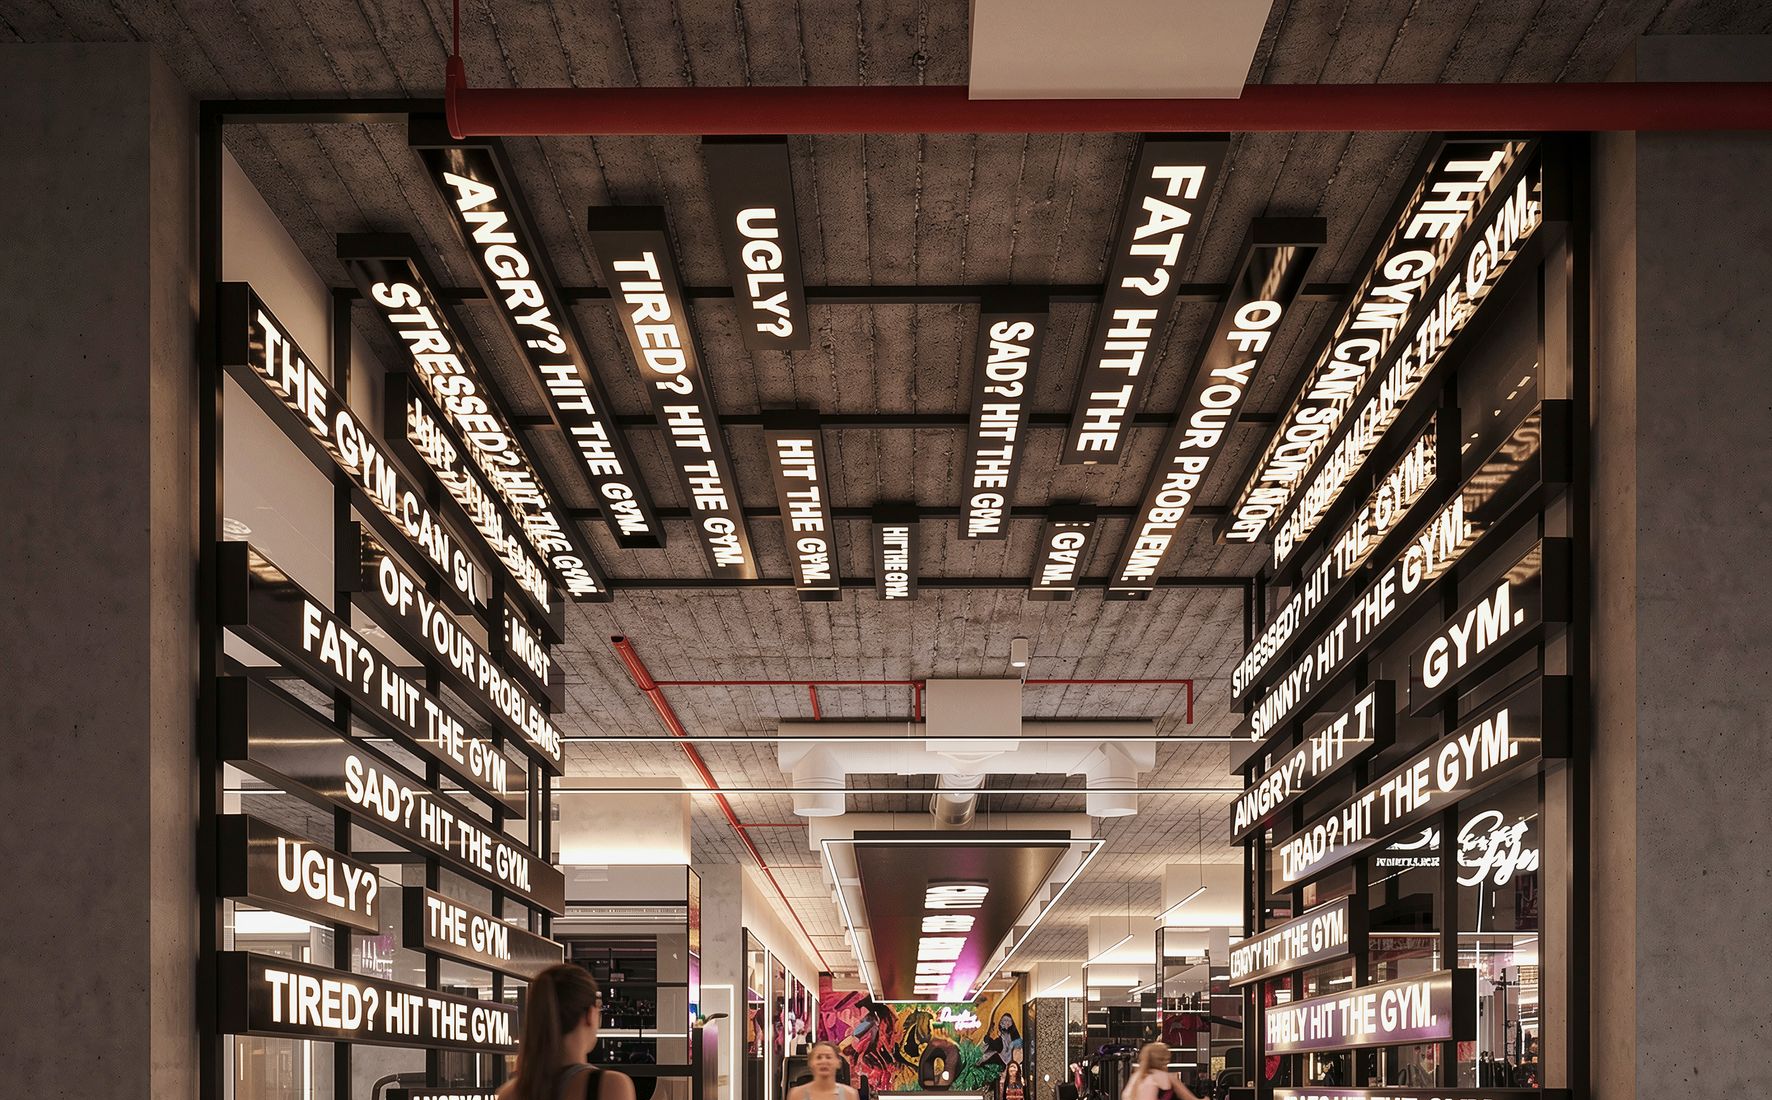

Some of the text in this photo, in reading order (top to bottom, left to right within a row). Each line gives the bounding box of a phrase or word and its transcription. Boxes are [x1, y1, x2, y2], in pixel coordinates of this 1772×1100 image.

[1404, 151, 1506, 239] THE
[735, 208, 794, 338] UGLY?
[1077, 165, 1207, 451] FAT? HIT THE
[1350, 250, 1435, 331] GYM
[443, 171, 567, 356] ANGRY?
[539, 364, 595, 415] HIT
[570, 421, 623, 477] THE
[613, 251, 694, 395] TIRED?
[983, 321, 1035, 398] SAD?
[1226, 301, 1282, 353] OF
[371, 282, 518, 467] STRESSED?
[1179, 360, 1258, 450] YOUR
[1308, 338, 1380, 400] CAN
[257, 309, 329, 437] THE
[335, 411, 397, 515] GYM
[403, 491, 450, 573] CAN
[663, 404, 711, 453] HIT
[777, 438, 815, 481] HIT
[979, 403, 1022, 441] HIT
[684, 460, 729, 511] THE
[974, 444, 1013, 489] THE
[785, 486, 825, 532] THE
[1233, 592, 1302, 698] STRESSED?
[1304, 553, 1332, 617] HIT
[1334, 506, 1370, 579] THE
[1317, 617, 1348, 681] HIT
[1352, 567, 1395, 644] THE
[1401, 494, 1471, 594] GYM.
[379, 556, 561, 761] OF YOUR PROBLEMS
[511, 616, 551, 687] MOST
[1422, 580, 1524, 689] GYM.
[303, 599, 375, 693] FAT?
[381, 664, 419, 728] HIT
[425, 698, 464, 764] THE
[1311, 713, 1349, 777] HIT
[1343, 791, 1374, 847] HIT
[1380, 757, 1431, 825] THE
[1436, 708, 1518, 793] GYM.
[345, 755, 531, 892] SAD? HIT THE GYM.
[277, 837, 378, 916] UGLY?
[427, 896, 511, 960] THE GYM.
[1263, 932, 1282, 968] HIT
[1283, 922, 1309, 961] THE
[1311, 908, 1348, 952] GYM.
[265, 969, 513, 1046] TIRED? HIT THE GYM.
[1310, 1001, 1337, 1040] HIT
[1339, 993, 1377, 1037] THE
[1380, 981, 1437, 1032] GYM.
